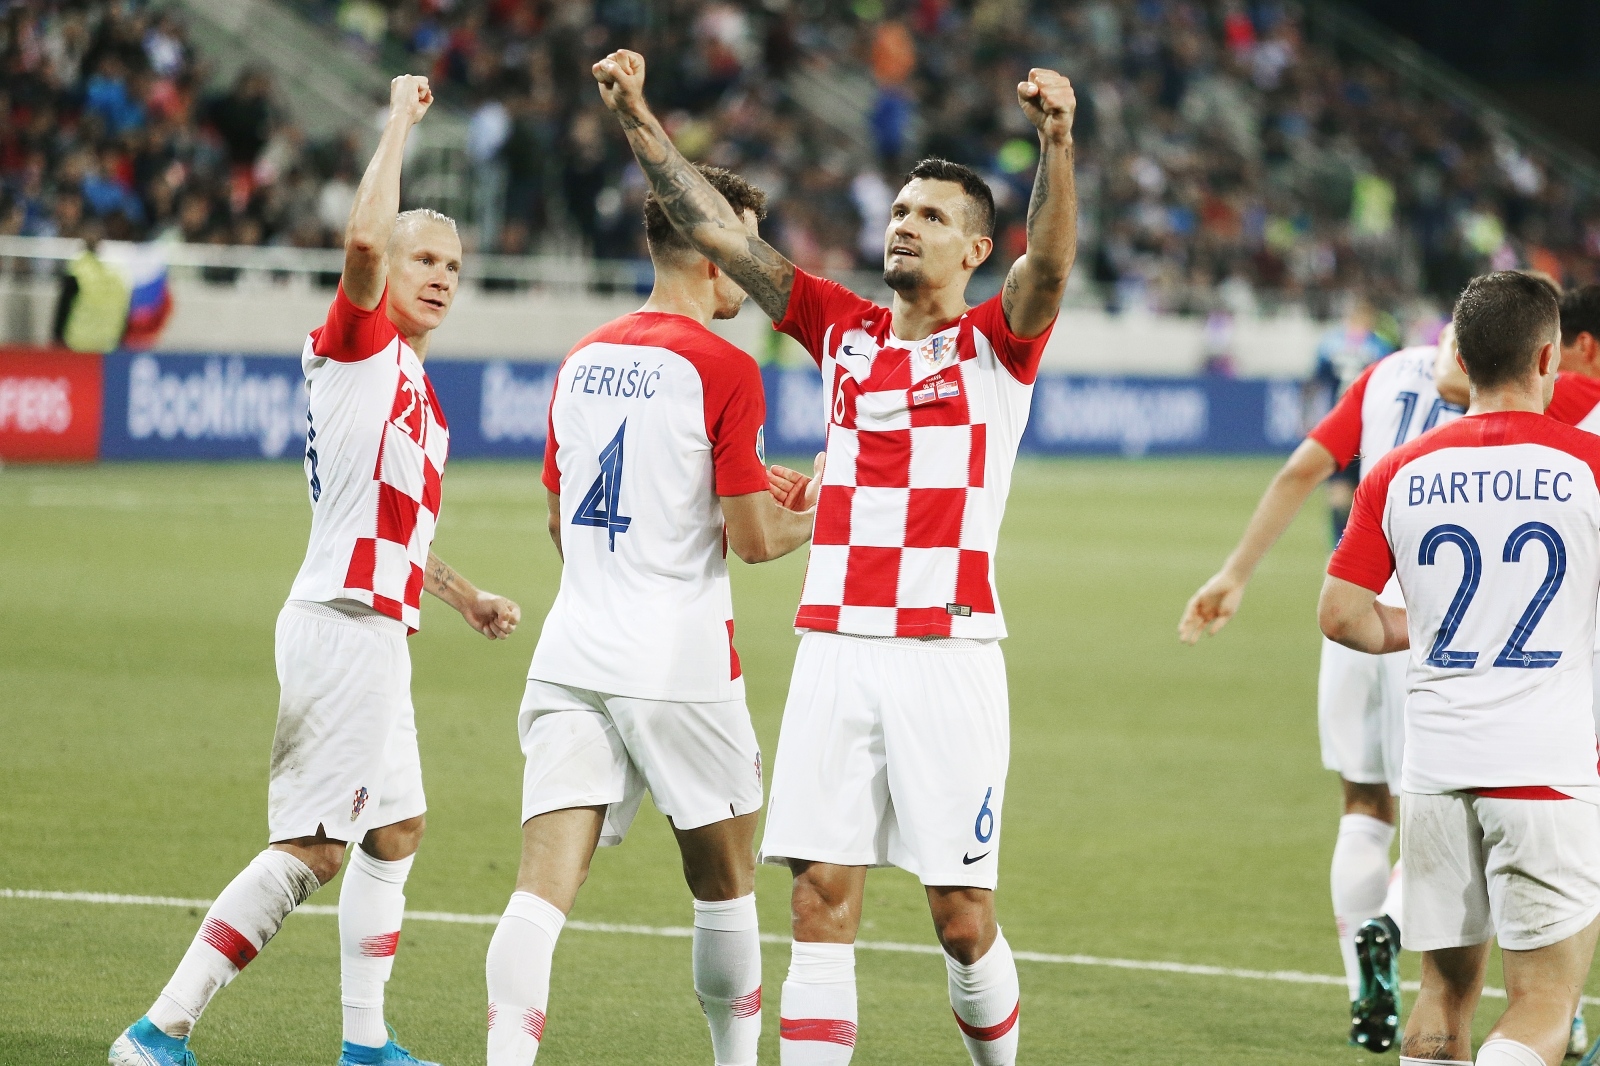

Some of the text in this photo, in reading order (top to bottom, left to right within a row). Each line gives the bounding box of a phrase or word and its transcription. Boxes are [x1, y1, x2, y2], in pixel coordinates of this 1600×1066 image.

[131, 352, 308, 456] Booking
[571, 362, 664, 399] PERIŠIĆ
[833, 372, 853, 425] 6
[393, 380, 426, 447] 21
[571, 416, 632, 552] 4
[1408, 468, 1573, 507] BARTOLEC
[1417, 521, 1567, 669] 22
[974, 786, 994, 844] 6
